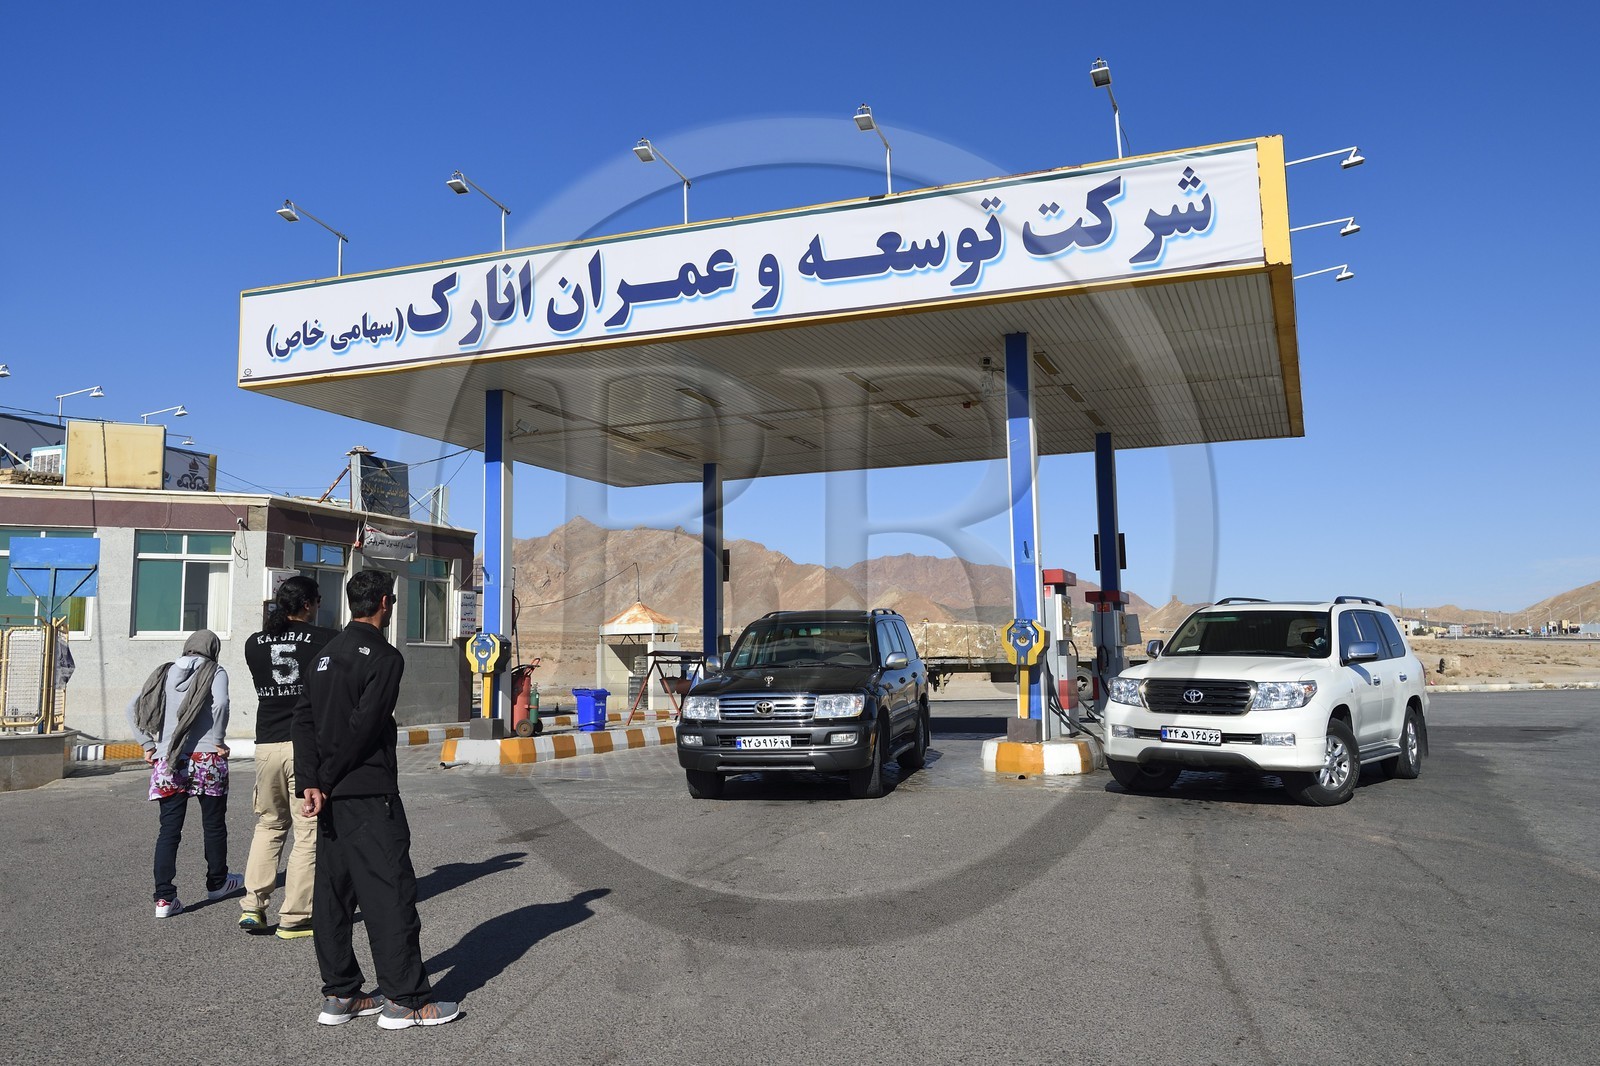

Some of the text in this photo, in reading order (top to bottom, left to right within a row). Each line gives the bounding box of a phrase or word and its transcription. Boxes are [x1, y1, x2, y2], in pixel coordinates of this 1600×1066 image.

[798, 196, 1002, 287] توسعه
[1022, 168, 1212, 264] شرکت
[406, 259, 532, 346] انارک
[546, 249, 735, 332] عمران
[751, 253, 780, 310] و
[270, 643, 300, 685] 5
